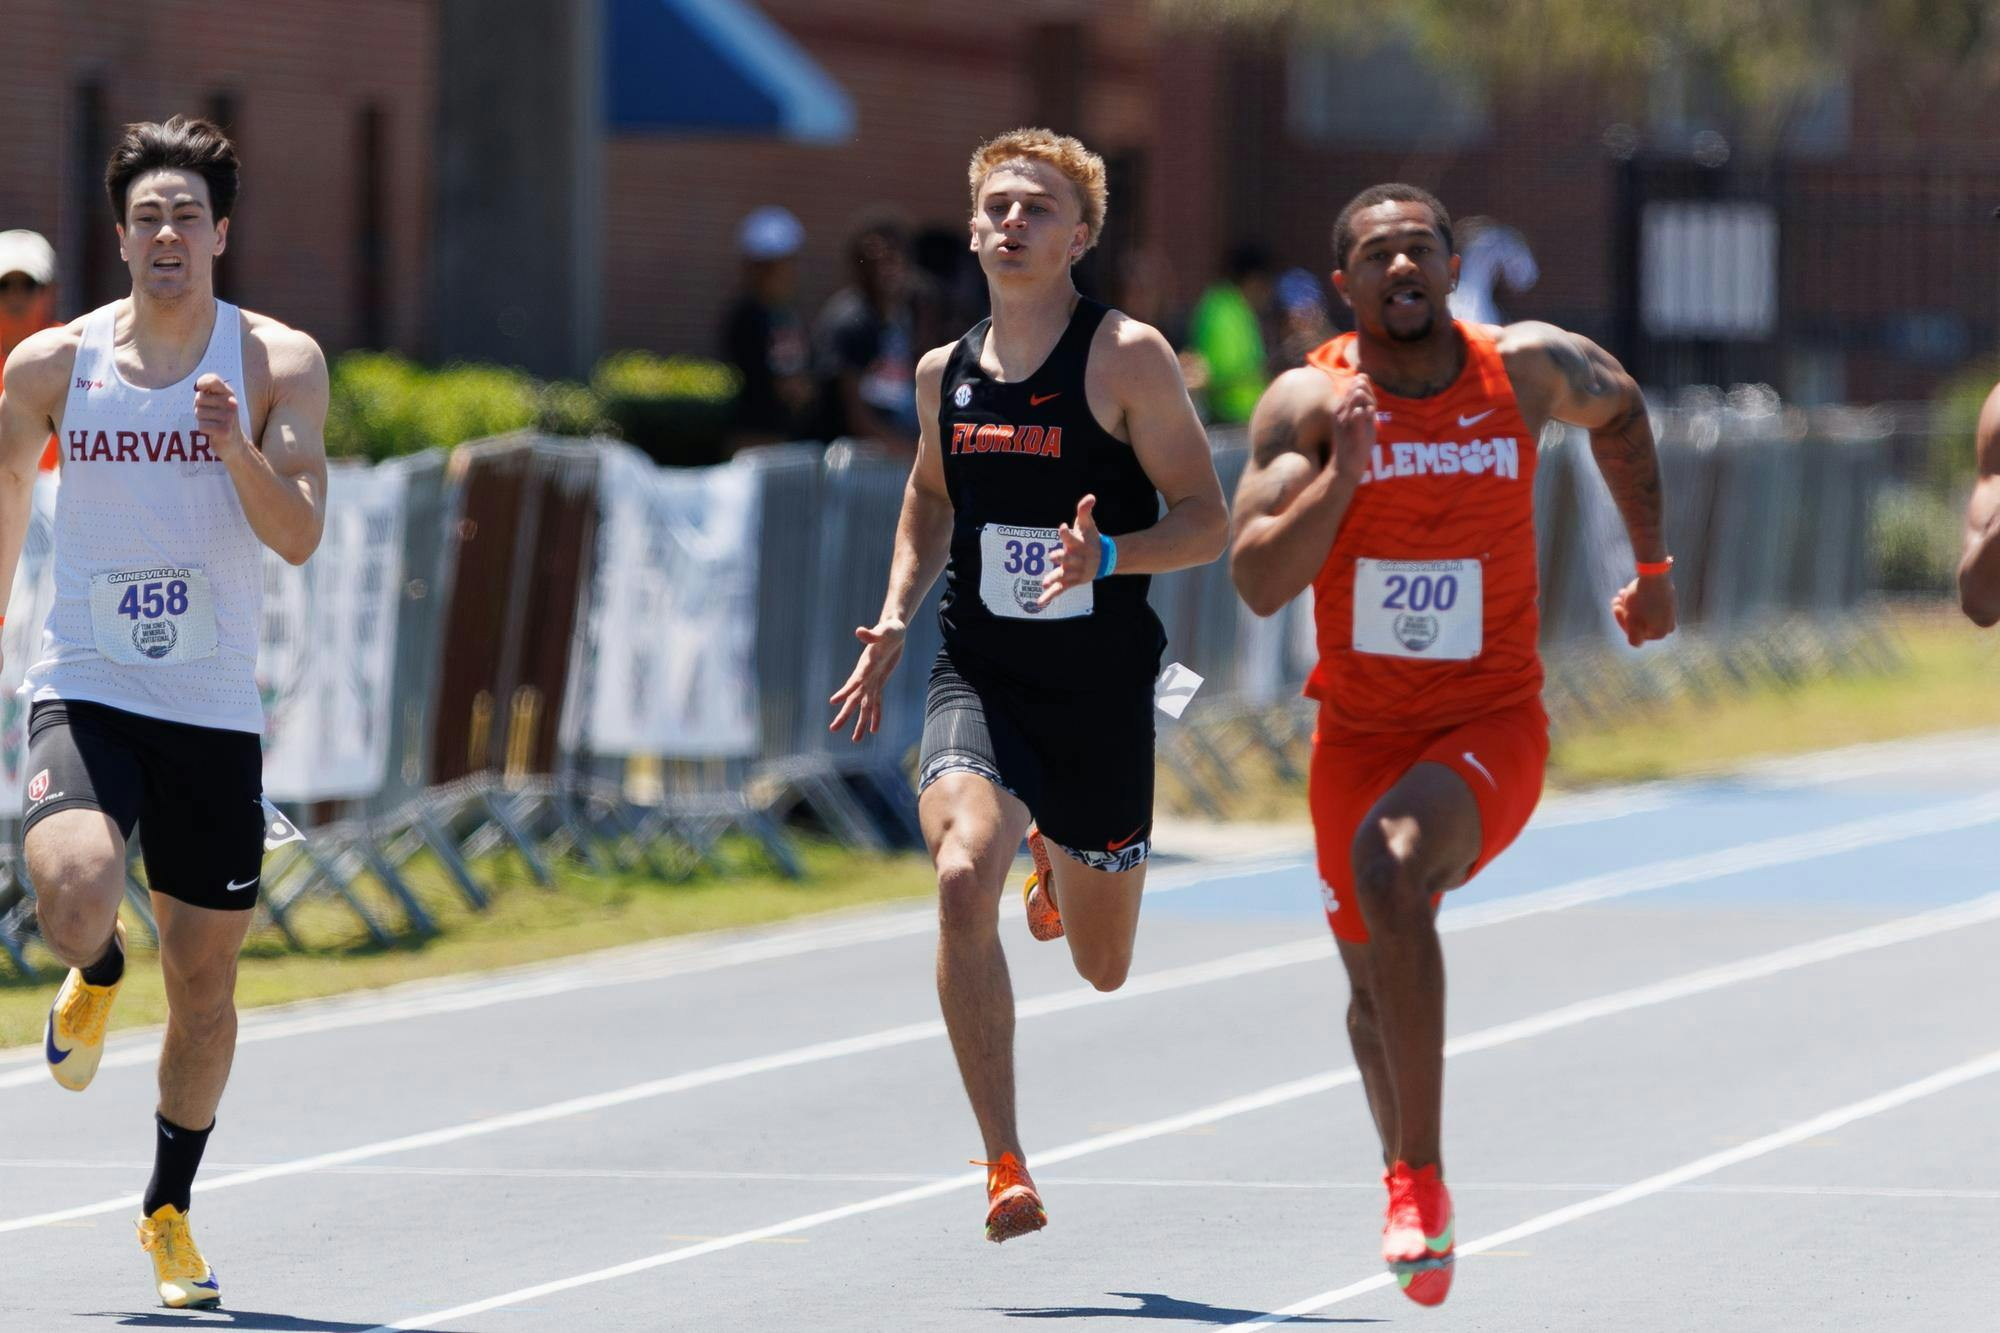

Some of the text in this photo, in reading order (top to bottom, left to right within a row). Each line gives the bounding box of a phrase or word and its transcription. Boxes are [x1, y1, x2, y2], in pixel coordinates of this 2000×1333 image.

[76, 377, 93, 391] Ivy
[68, 430, 223, 462] HARVAR
[951, 423, 1062, 458] FLORIDA
[1004, 540, 1064, 576] 38
[108, 568, 191, 584] GAINESVILLE, FL
[1382, 574, 1458, 611] 200
[117, 579, 189, 620] 458
